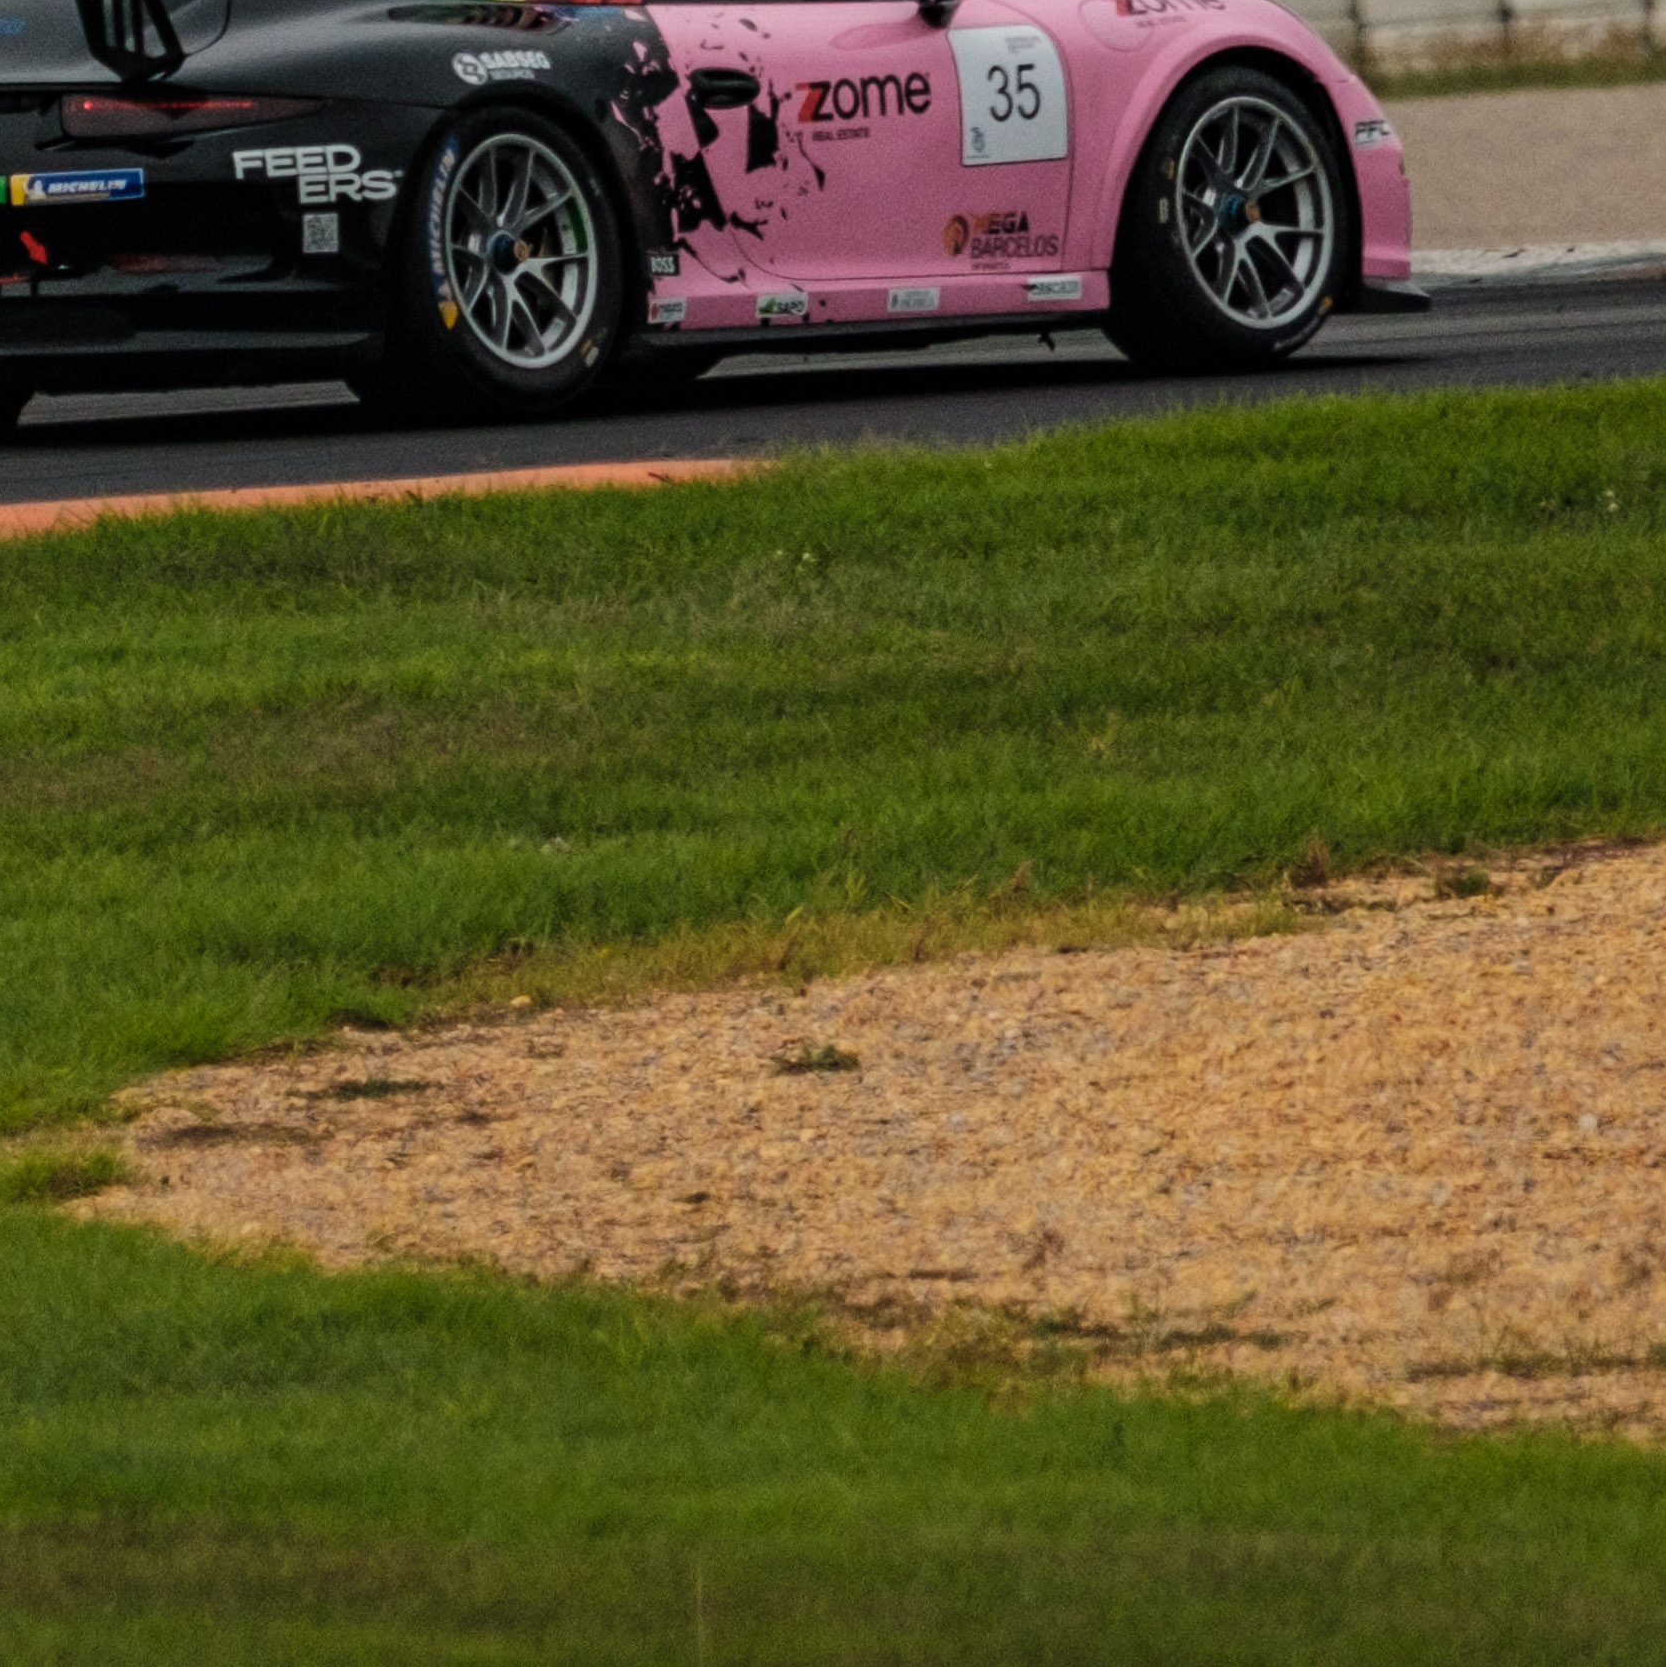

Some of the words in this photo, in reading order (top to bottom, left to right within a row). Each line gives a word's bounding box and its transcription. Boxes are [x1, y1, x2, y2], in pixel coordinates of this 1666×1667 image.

[795, 72, 932, 123] zome
[987, 63, 1041, 123] 35
[232, 145, 361, 180] FEED
[48, 179, 127, 195] MICHELIN
[298, 170, 398, 204] ERS
[970, 234, 1060, 260] BARCELOS
